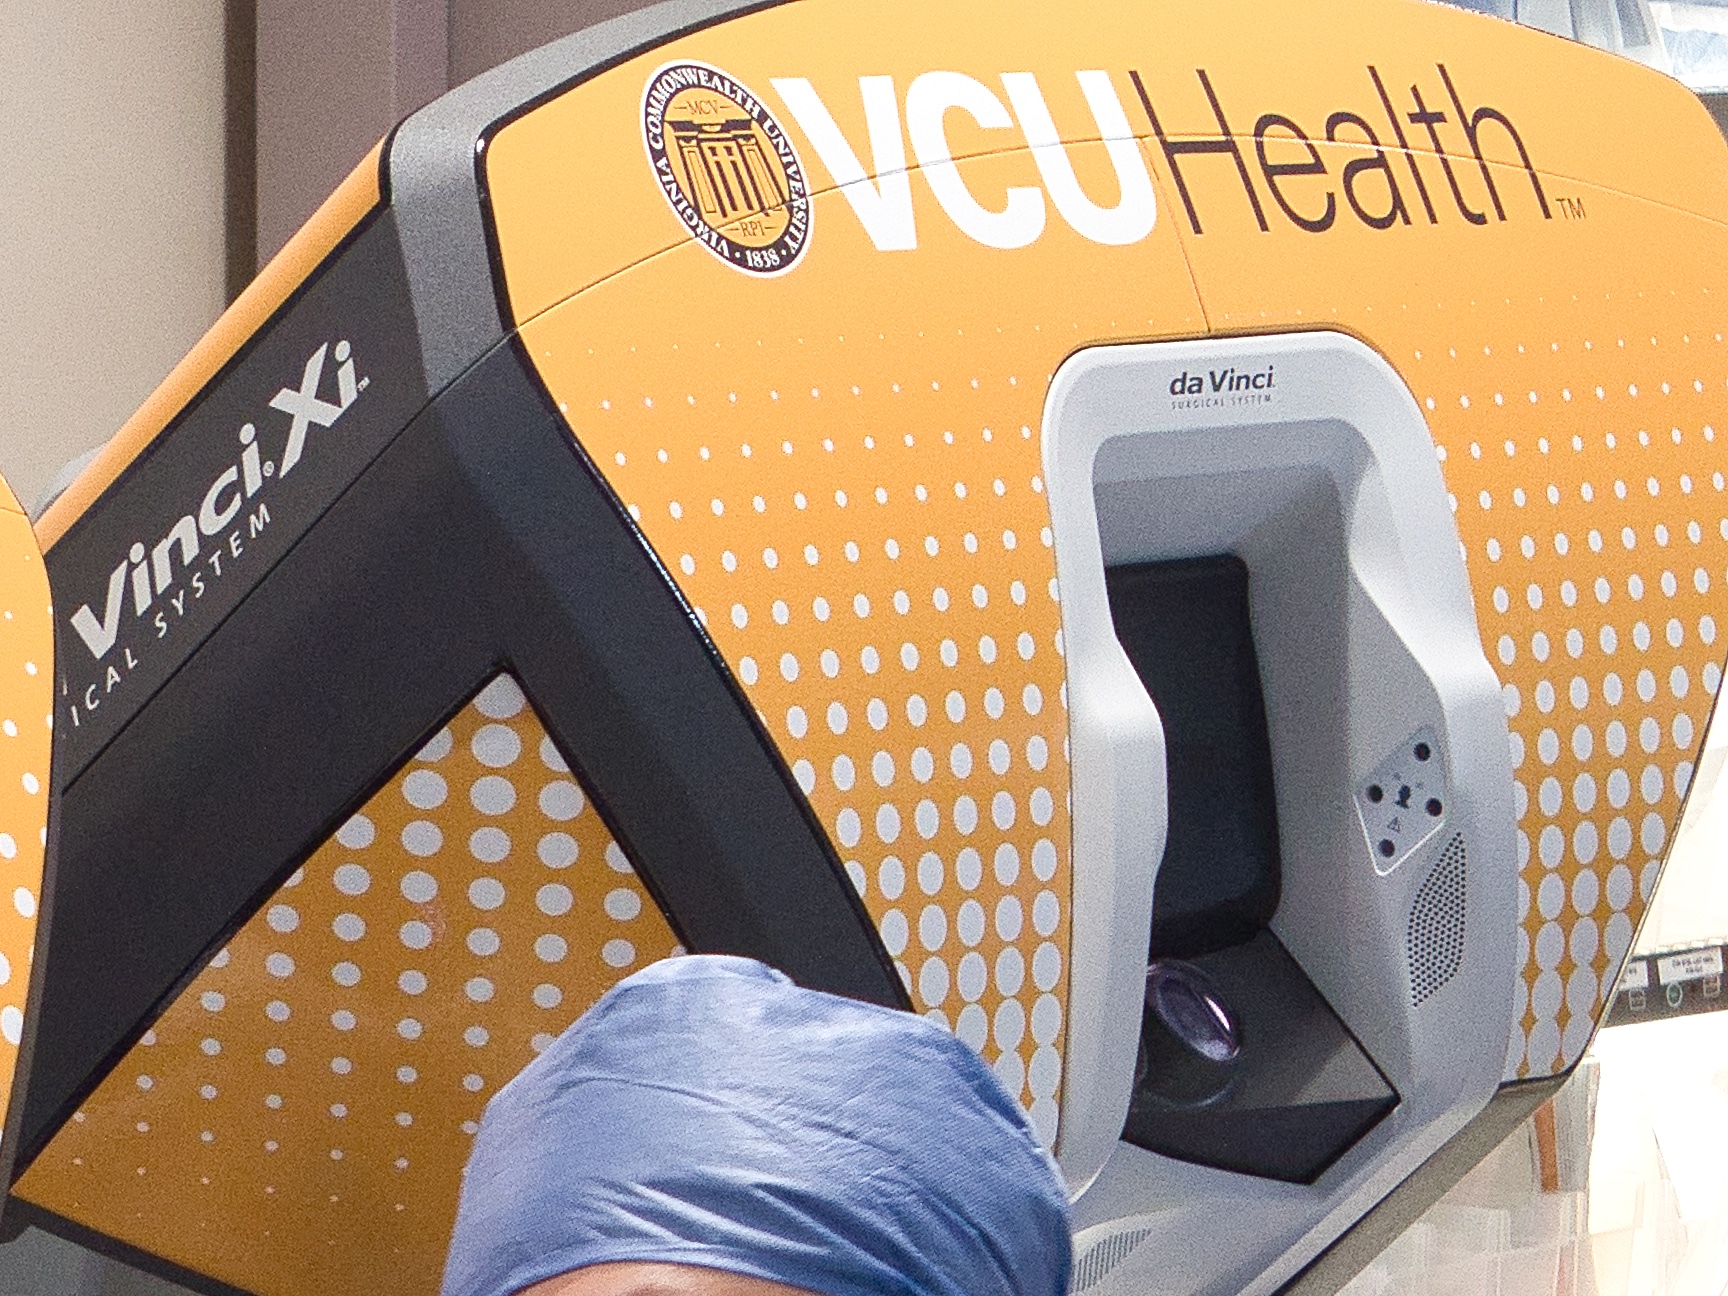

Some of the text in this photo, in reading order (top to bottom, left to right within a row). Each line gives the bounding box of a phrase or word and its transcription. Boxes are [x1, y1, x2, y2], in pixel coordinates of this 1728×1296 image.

[684, 99, 722, 115] MCV
[647, 67, 808, 267] VIRGINIA COMMONWEALTH UNIVERSITY 1838
[740, 220, 766, 238] RPI
[1169, 364, 1274, 396] da Vinci
[70, 339, 359, 660] Vinci Xi
[70, 502, 272, 727] ICAL SYSTEM
